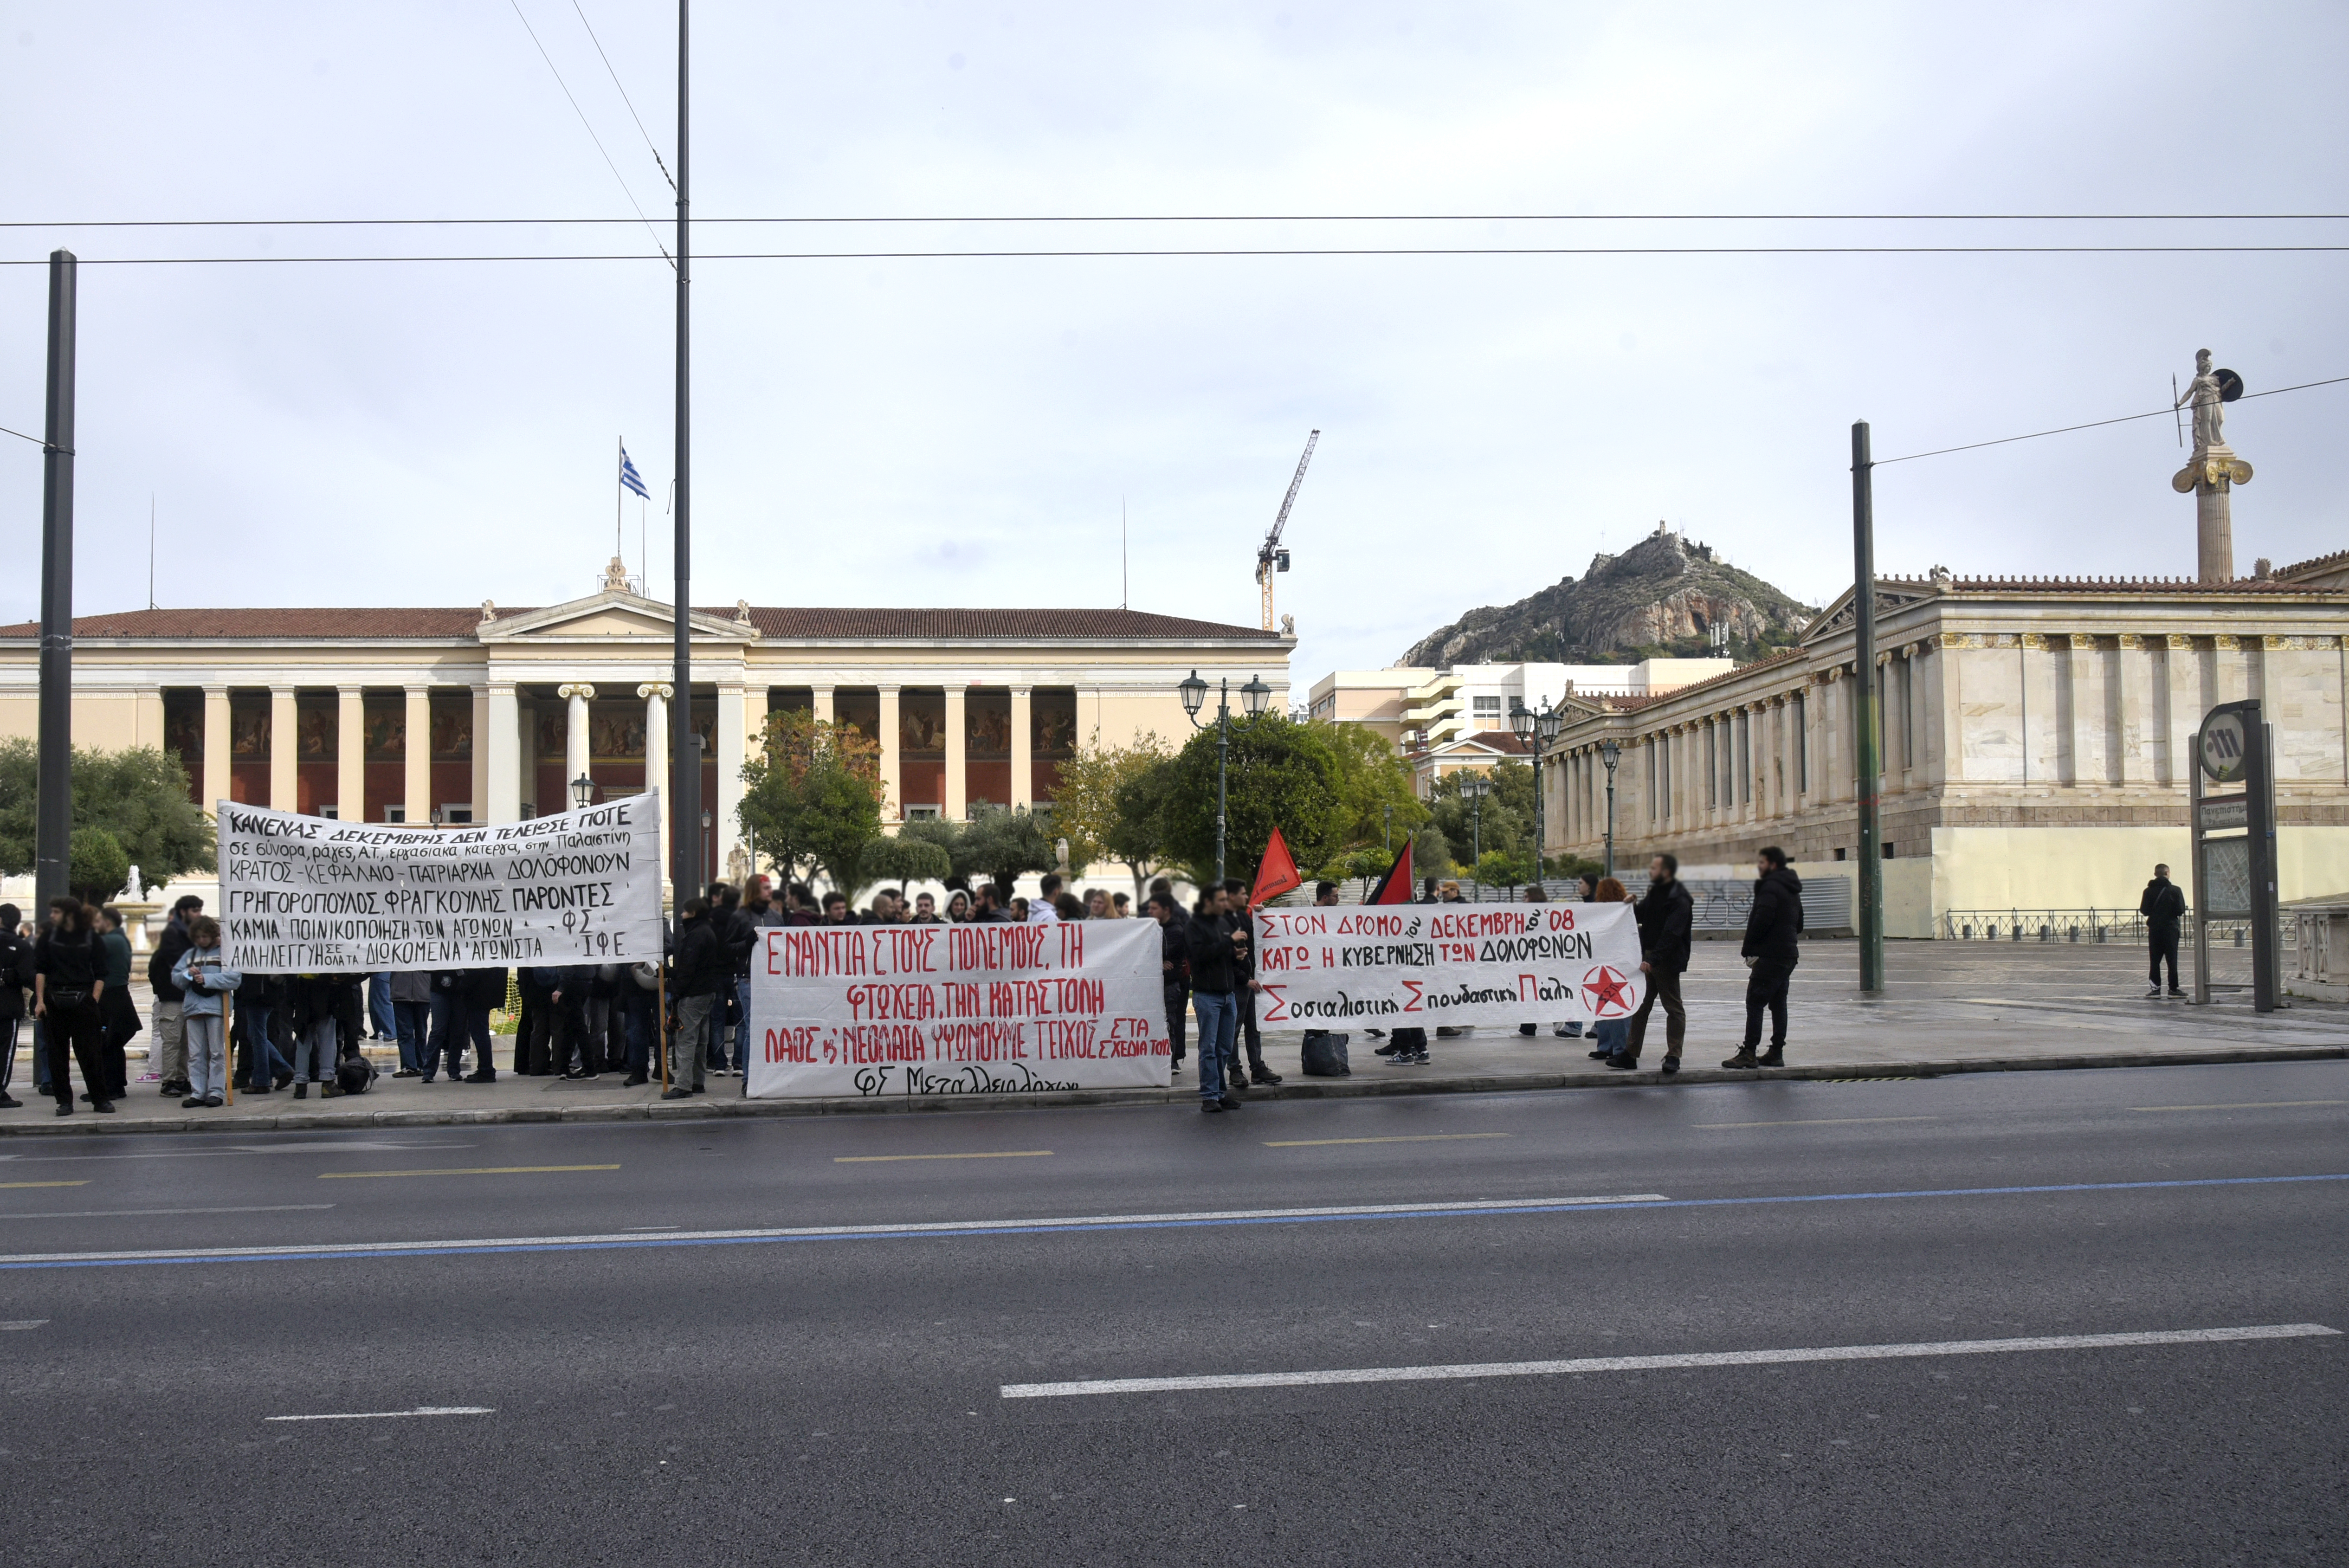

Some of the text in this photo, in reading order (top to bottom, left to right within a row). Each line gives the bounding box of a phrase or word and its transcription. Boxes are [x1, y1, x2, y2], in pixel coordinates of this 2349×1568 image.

[2201, 803, 2247, 815] Πανεπιστήμι
[230, 803, 632, 845] ΚΑΝΕΝΑΣ ΔΕΚΕΜΒΡΗΣ ΔΕΝ ΤΕΛΕΙΩΣΕ ΠΟΤΕ
[229, 841, 250, 856] σε
[525, 840, 549, 854] στην
[556, 827, 631, 850] Παλαιστίνη
[230, 859, 296, 883] ΚΡΑΤΟΣ
[305, 863, 394, 884] ΚΕΦΑΛΑΙΟ
[407, 861, 495, 883] ΠΑΤΡΙΑΡΧΙΑ
[508, 852, 630, 880] ΔΟΛΟΦΟΝΟΥΝ
[230, 882, 614, 916] ΓΡΗΓΟΡΟΠΟΥΛΟΣ, ΦΡΑΓΚΟΥΛΗΣ ΠΑΡΟΝΤΕΣ
[230, 917, 512, 941] ΚΑΜΙΑ ΠΟΙΝΙΚΟΠΟΙΗΣΗ ΤΩΝ ΑΓΩΝΩΝ
[562, 909, 594, 935] ΦΣ
[1258, 913, 1327, 938] ΣΤΟΝ
[1336, 914, 1402, 937] ΔΡΟΜΟ
[1404, 916, 1422, 939] του
[1430, 912, 1525, 939] ΔΕΚΕΜΒΡΗ
[1525, 909, 1541, 932] του
[231, 942, 324, 968] ΑΛΛΗΛΕΓΓΥΗ
[326, 944, 344, 954] ΣΕ
[366, 941, 461, 965] ΔΙΩΚΟΜΕΝΑ
[325, 955, 359, 966] ΟΛΑ ΤΑ
[767, 930, 866, 977] ΕΝΑΝΤΙΑ
[872, 928, 941, 976] ΣΤΟΥΣ
[1057, 923, 1083, 970] ΤΗ
[1262, 946, 1311, 971] ΚΑΤΩ
[1322, 947, 1334, 968] Η
[1342, 942, 1435, 967] ΚΥΒΕΡΝΗΣΗ
[1439, 943, 1475, 962] ΤΩΝ
[942, 981, 981, 1019] ΤΗΝ
[989, 978, 1104, 1019] ΚΑΤΑΣΤΟΛΗ
[1262, 974, 1574, 1021] Σοσιαλιστική Σπουδαστική Πάλη
[765, 1026, 821, 1064] ΛΑΟΣ
[843, 1024, 926, 1065] ΝΕΟΛΑΙΑ
[931, 1020, 1029, 1062] ΥΨΩΝΟΥΜΕ
[1033, 1019, 1099, 1061] ΤΕΙΧΟΣ
[1110, 1018, 1149, 1039] ΣΤΑ
[1098, 1039, 1148, 1059] ΣΧΕΔΙΑ
